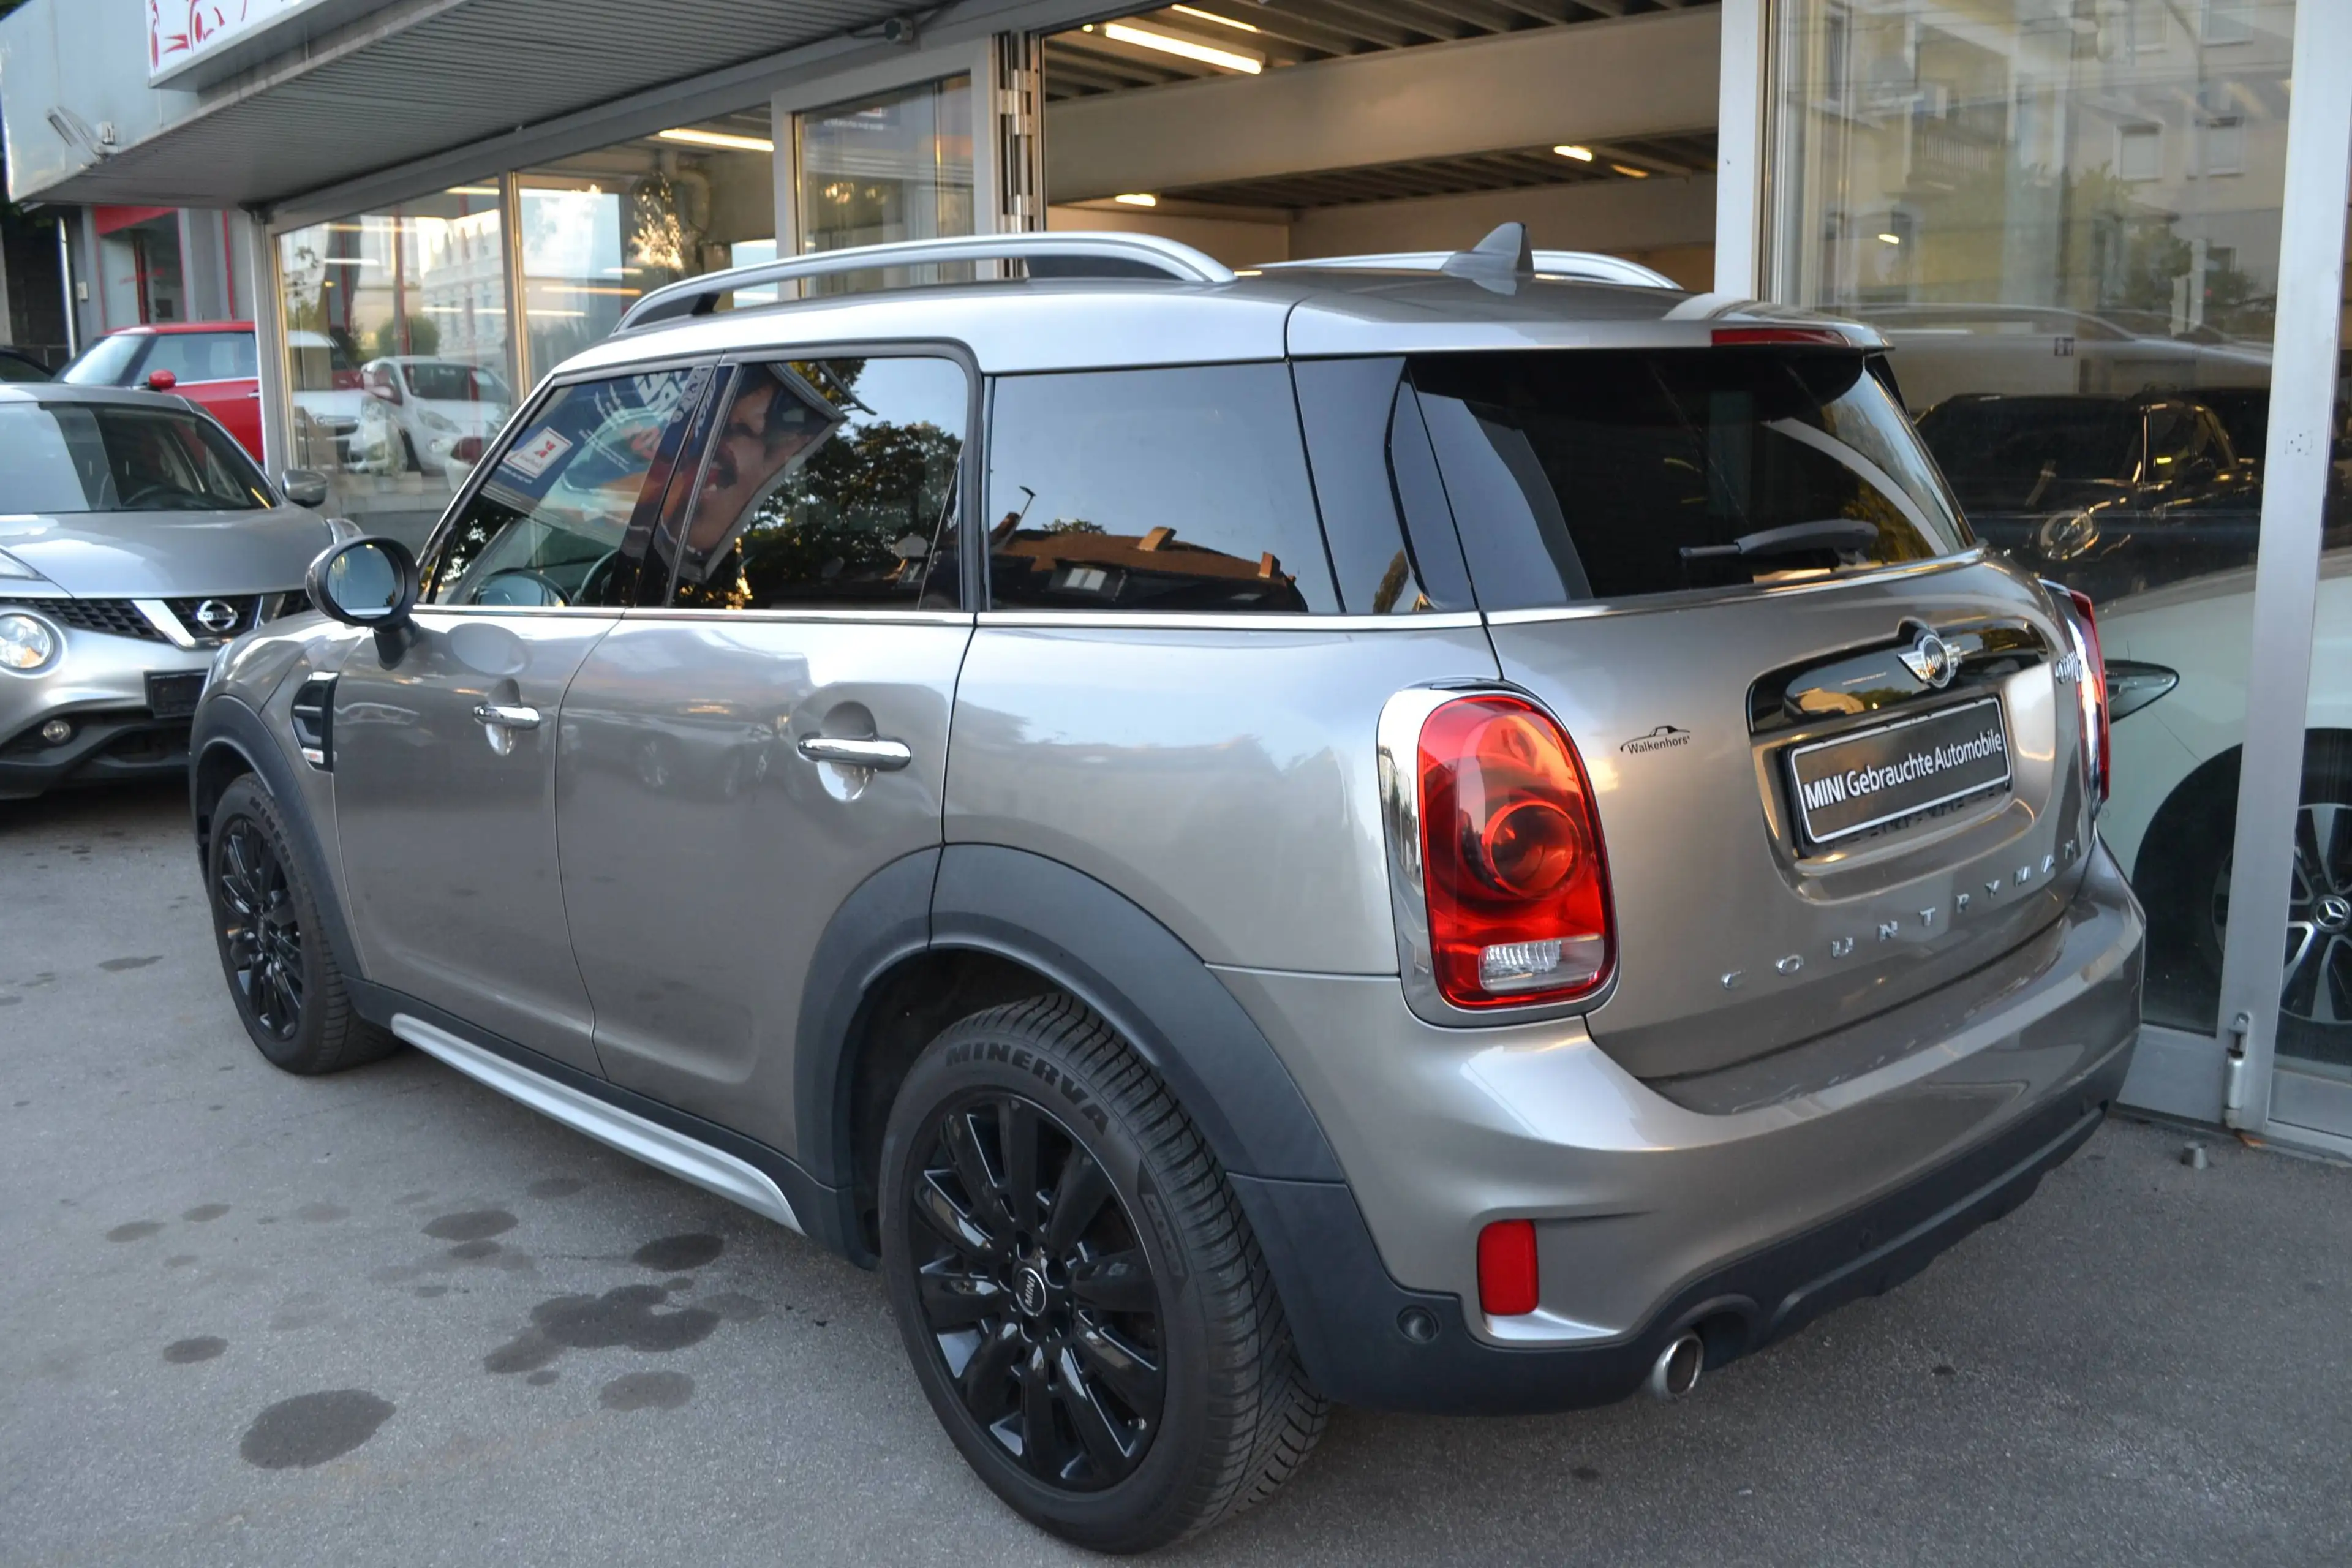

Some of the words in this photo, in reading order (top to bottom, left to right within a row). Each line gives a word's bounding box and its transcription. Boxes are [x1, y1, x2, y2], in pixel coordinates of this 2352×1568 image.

[1804, 775, 1846, 810] MINI
[1847, 753, 1934, 796] Gebrauchte
[1935, 728, 2002, 771] Automobile
[1721, 839, 2075, 991] COUNTRYMAN
[945, 1043, 1109, 1137] MINERVA
[1025, 1275, 1035, 1307] MINI
